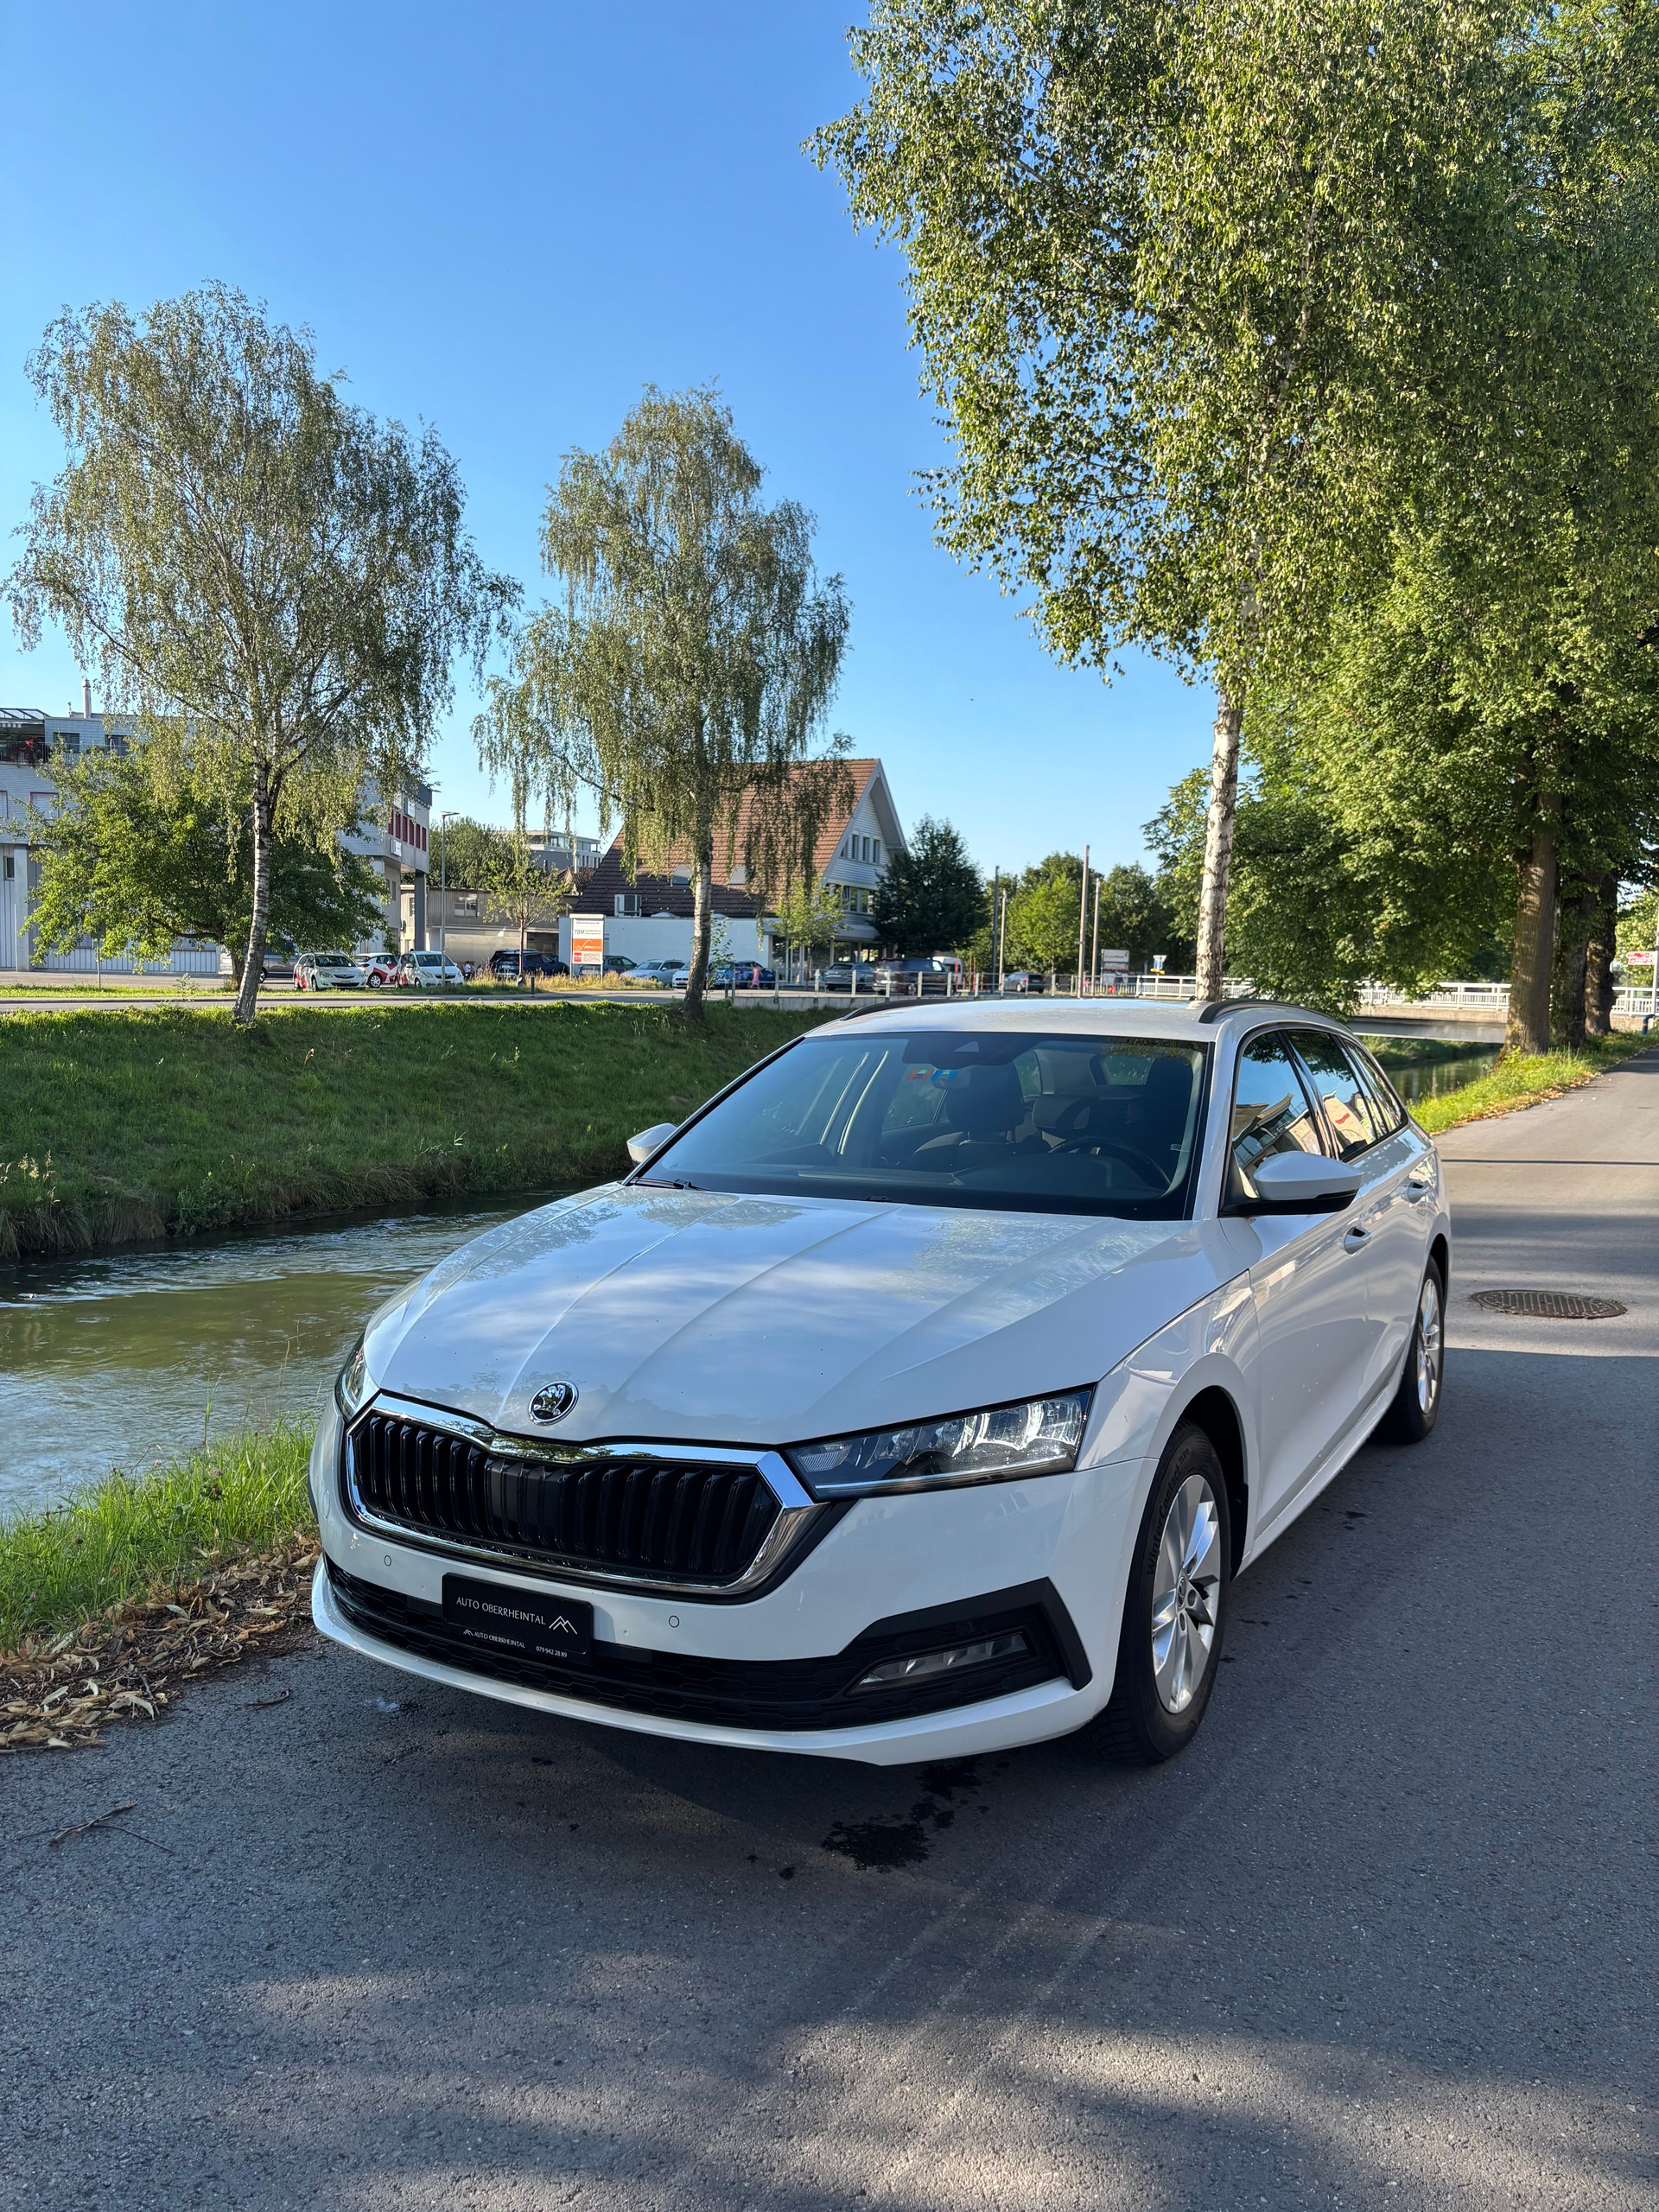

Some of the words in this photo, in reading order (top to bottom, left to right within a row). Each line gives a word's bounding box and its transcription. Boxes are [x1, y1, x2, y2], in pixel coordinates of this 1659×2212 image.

[456, 1597, 480, 1610] AUTO
[482, 1602, 546, 1625] OBERRHEINTAL
[474, 1631, 488, 1640] AUTO
[489, 1634, 526, 1649] OBERRHEINTAL
